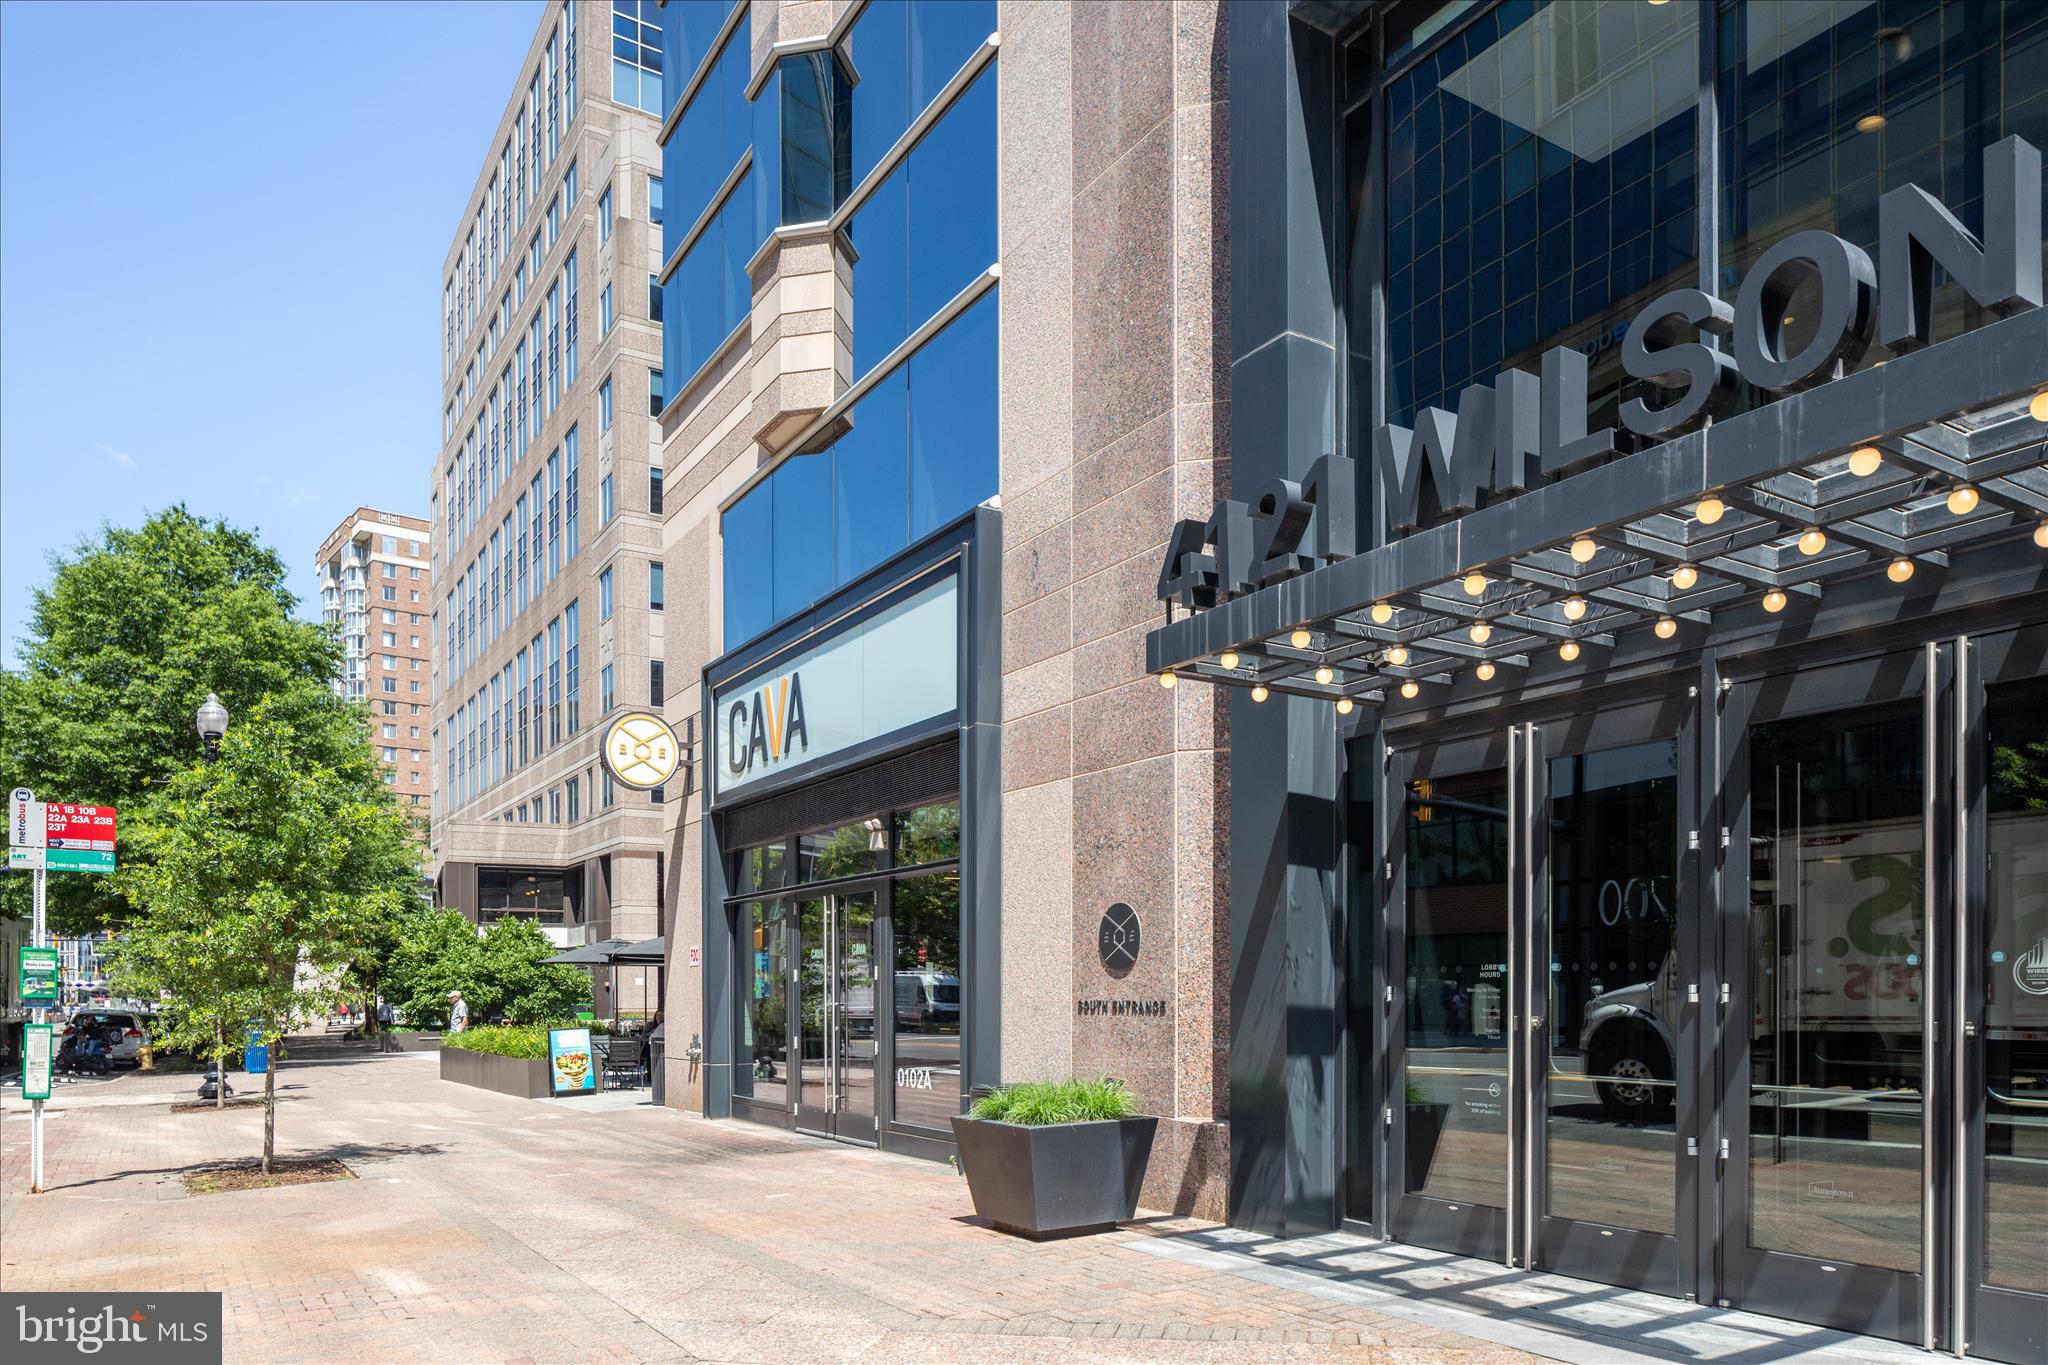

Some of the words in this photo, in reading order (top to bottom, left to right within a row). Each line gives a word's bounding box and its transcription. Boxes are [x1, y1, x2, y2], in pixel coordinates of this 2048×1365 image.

[1158, 454, 1356, 608] 4121
[1375, 133, 2043, 532] WILSON
[728, 671, 808, 774] CAVA
[48, 805, 60, 813] 1A
[63, 805, 75, 814] 1B
[79, 807, 97, 815] 10B
[17, 803, 26, 844] metrobus
[48, 814, 68, 823] 22A
[71, 815, 91, 824] 23A
[94, 816, 113, 825] 23B
[48, 823, 67, 831] 23T
[101, 852, 112, 861] 72
[1077, 1000, 1108, 1016] SOUTH
[1112, 1000, 1167, 1017] ENTRANCE
[897, 1067, 932, 1090] 0102A
